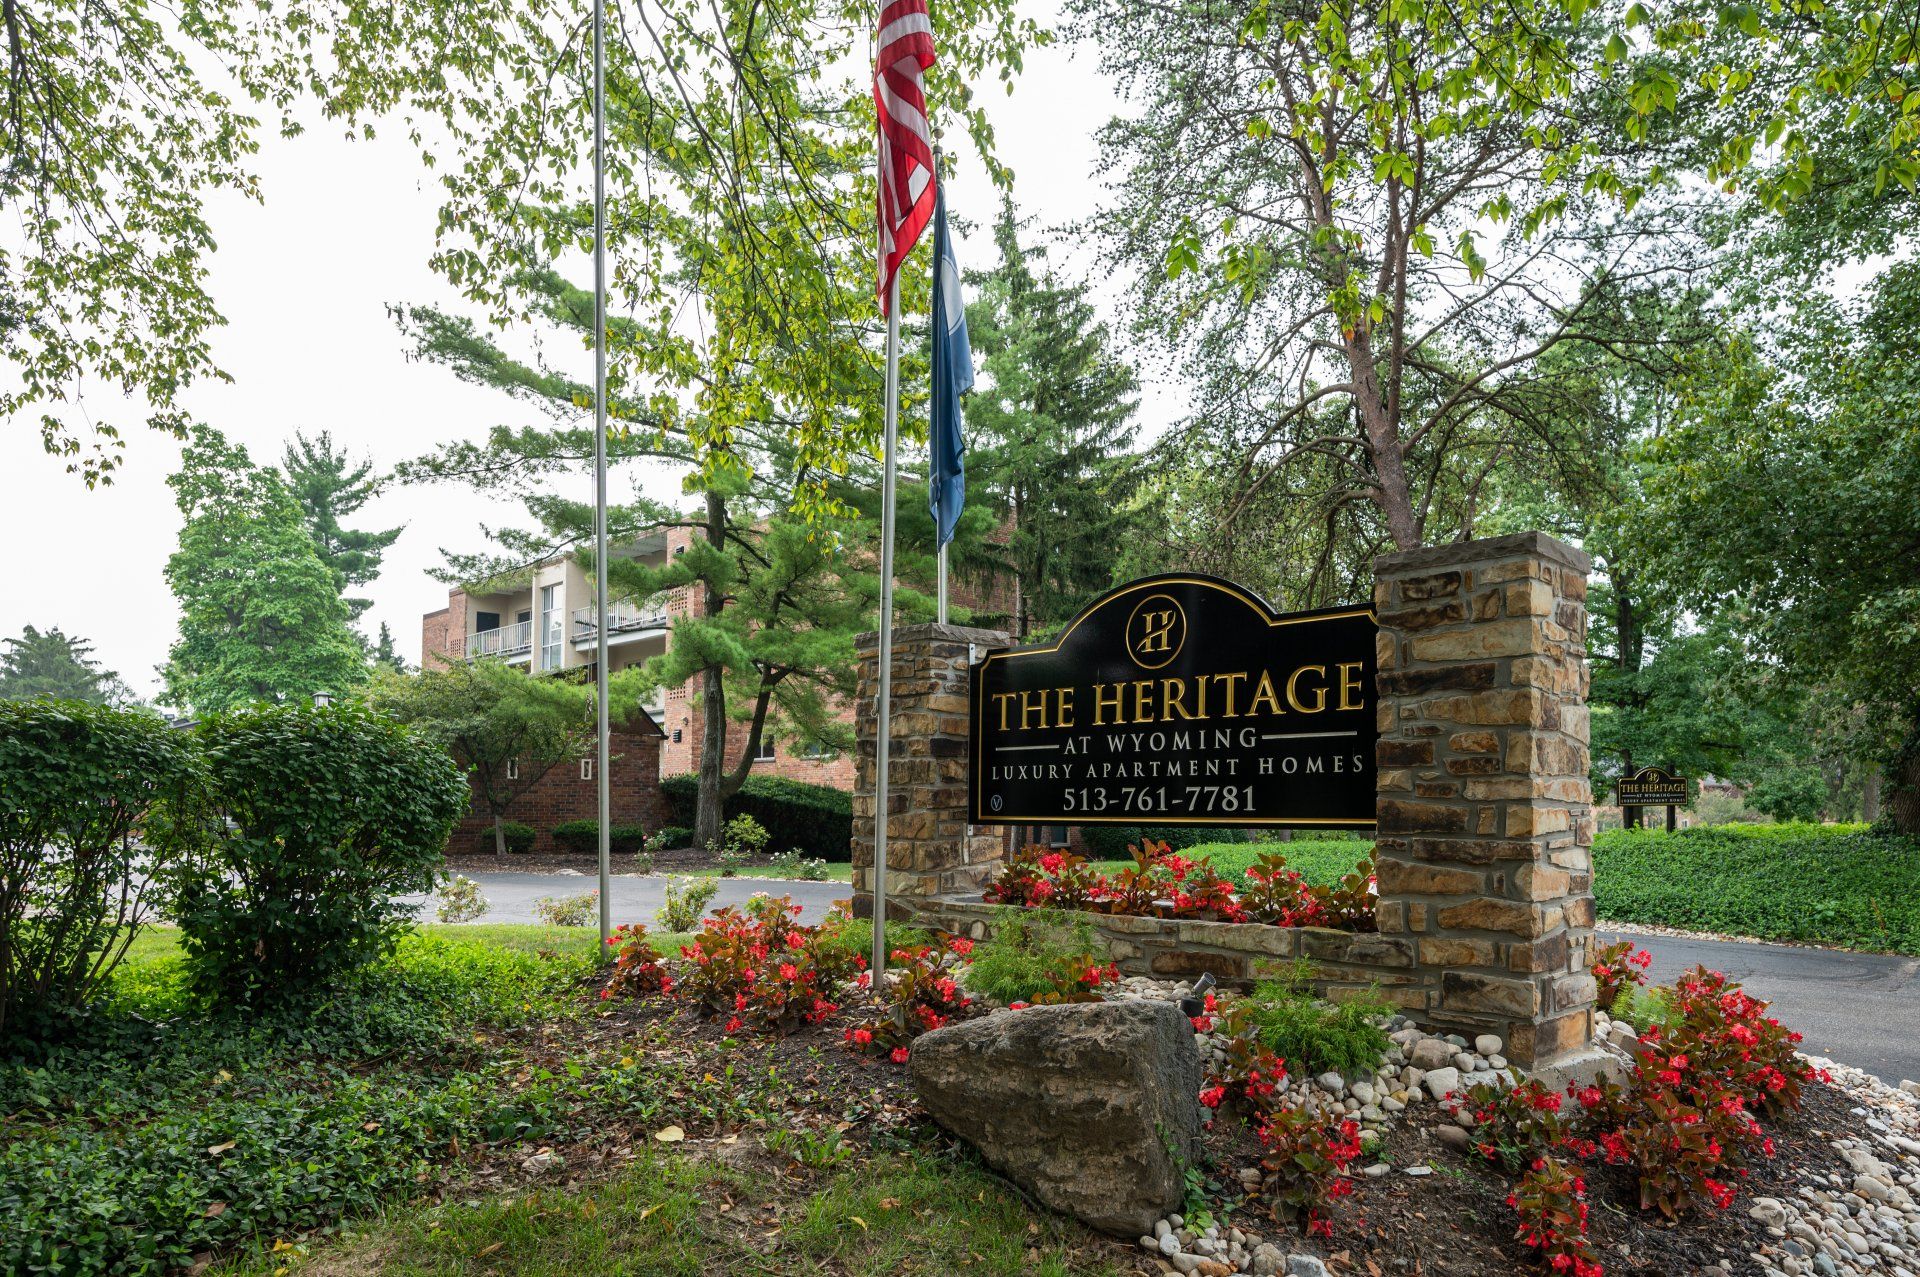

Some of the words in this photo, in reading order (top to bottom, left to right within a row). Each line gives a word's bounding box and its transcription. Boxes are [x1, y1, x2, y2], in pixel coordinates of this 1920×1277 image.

[992, 686, 1075, 732] THE
[1092, 662, 1365, 726] HERITAGE
[1063, 736, 1091, 755] AT
[1108, 727, 1258, 753] WYOMING
[992, 764, 1073, 781] LUXURY
[1086, 758, 1240, 779] APARTMENT
[1258, 755, 1364, 775] HOMES
[1063, 786, 1256, 812] 513-761-7781
[1621, 784, 1639, 793] THE
[1641, 783, 1686, 792] HERITAGE
